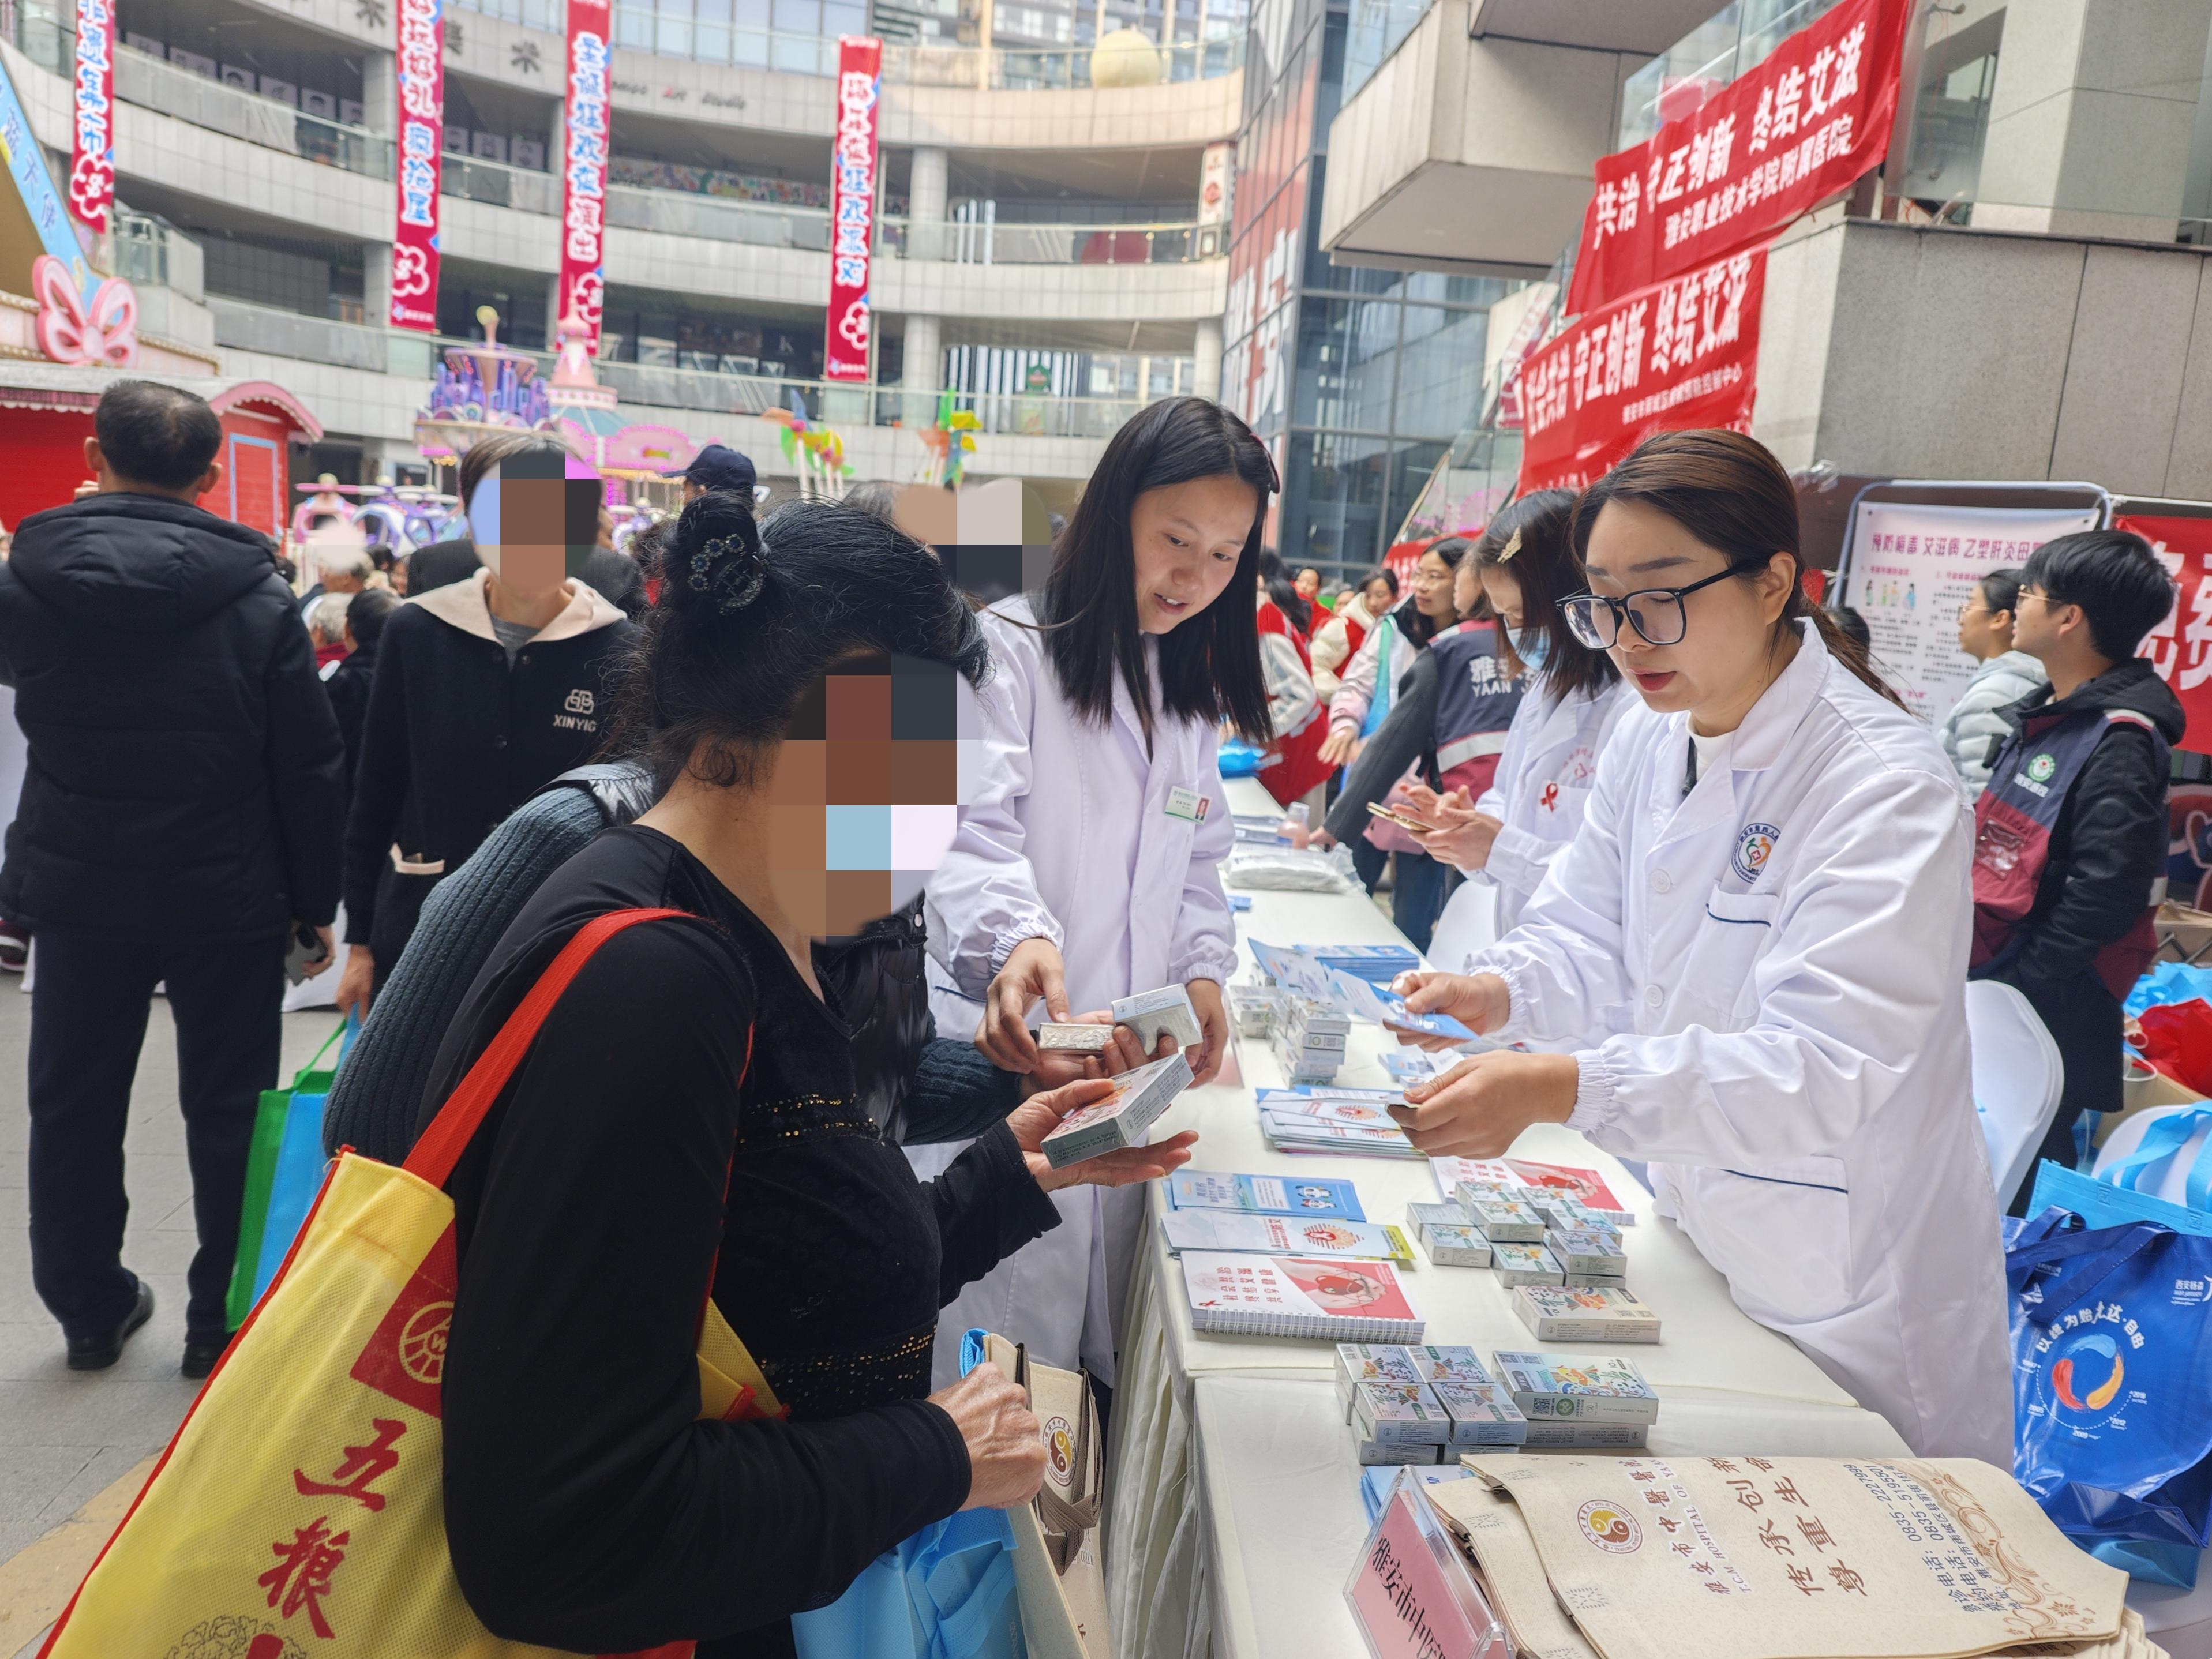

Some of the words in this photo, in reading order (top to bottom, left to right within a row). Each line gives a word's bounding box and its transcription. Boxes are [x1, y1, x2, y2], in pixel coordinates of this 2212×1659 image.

[1594, 172, 1640, 250] 共治
[1748, 22, 1866, 154] 终结艾滋
[1527, 342, 1570, 440] 社会共治
[1574, 299, 1648, 410] 守正创新
[1651, 250, 1752, 375] 终结艾滋
[1923, 537, 1960, 557] 艾滋病
[1472, 680, 1512, 698] YAAN
[1216, 1267, 1239, 1301] 社会共治
[1236, 1267, 1260, 1303] 终结艾滋
[1259, 1268, 1283, 1304] 共享健康
[1673, 1484, 1688, 1498] OF
[245, 1418, 407, 1659] 五粮
[1686, 1506, 1726, 1560] HOSPITAL
[1701, 1457, 1825, 1596] 传承创新
[1744, 1457, 1868, 1597] 尊重生命
[1373, 1536, 1445, 1659] 雅安市中医
